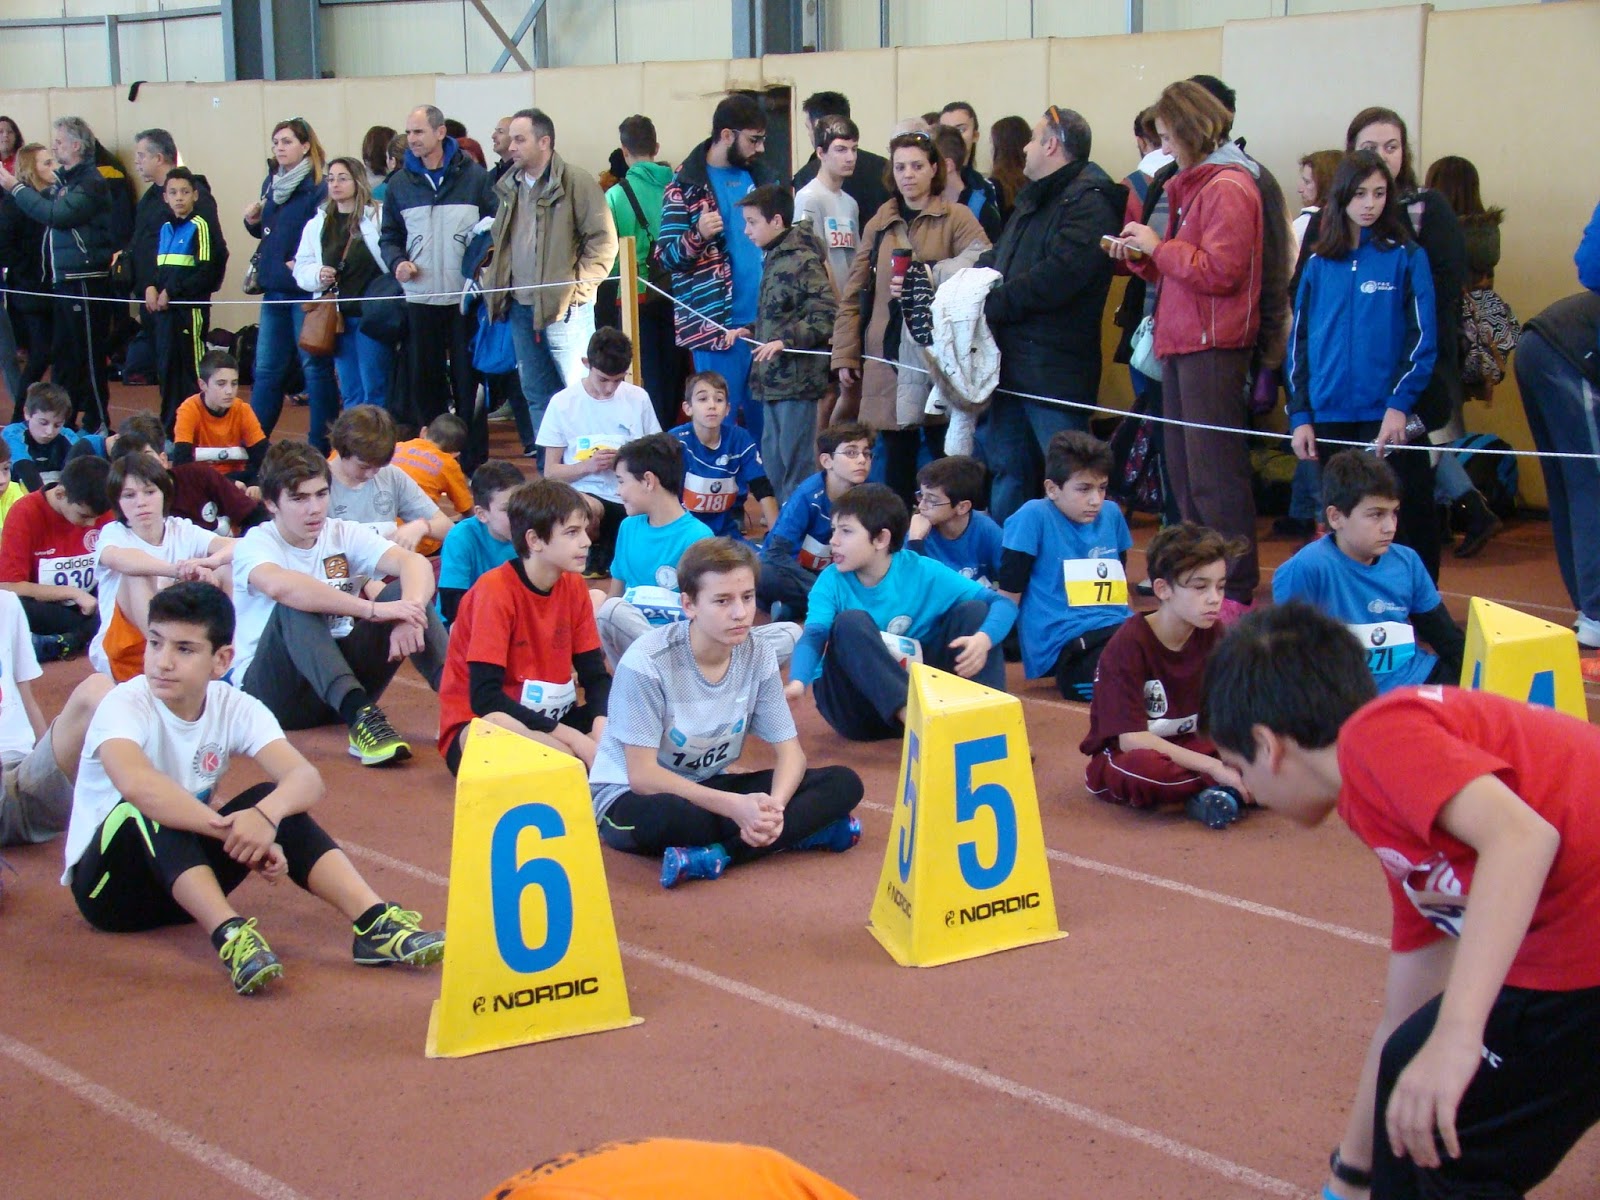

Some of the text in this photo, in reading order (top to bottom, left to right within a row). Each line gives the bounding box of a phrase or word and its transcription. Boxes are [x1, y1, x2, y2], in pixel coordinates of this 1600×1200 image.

[694, 494, 729, 511] 2181
[54, 568, 94, 588] 930
[55, 557, 95, 570] adidas
[1094, 581, 1112, 602] 77
[672, 742, 730, 770] 1462
[954, 734, 1018, 890] 5
[491, 802, 573, 974] 6
[892, 885, 912, 919] NORDIC
[959, 892, 1041, 925] NORDIC
[493, 977, 600, 1013] NORDIC
